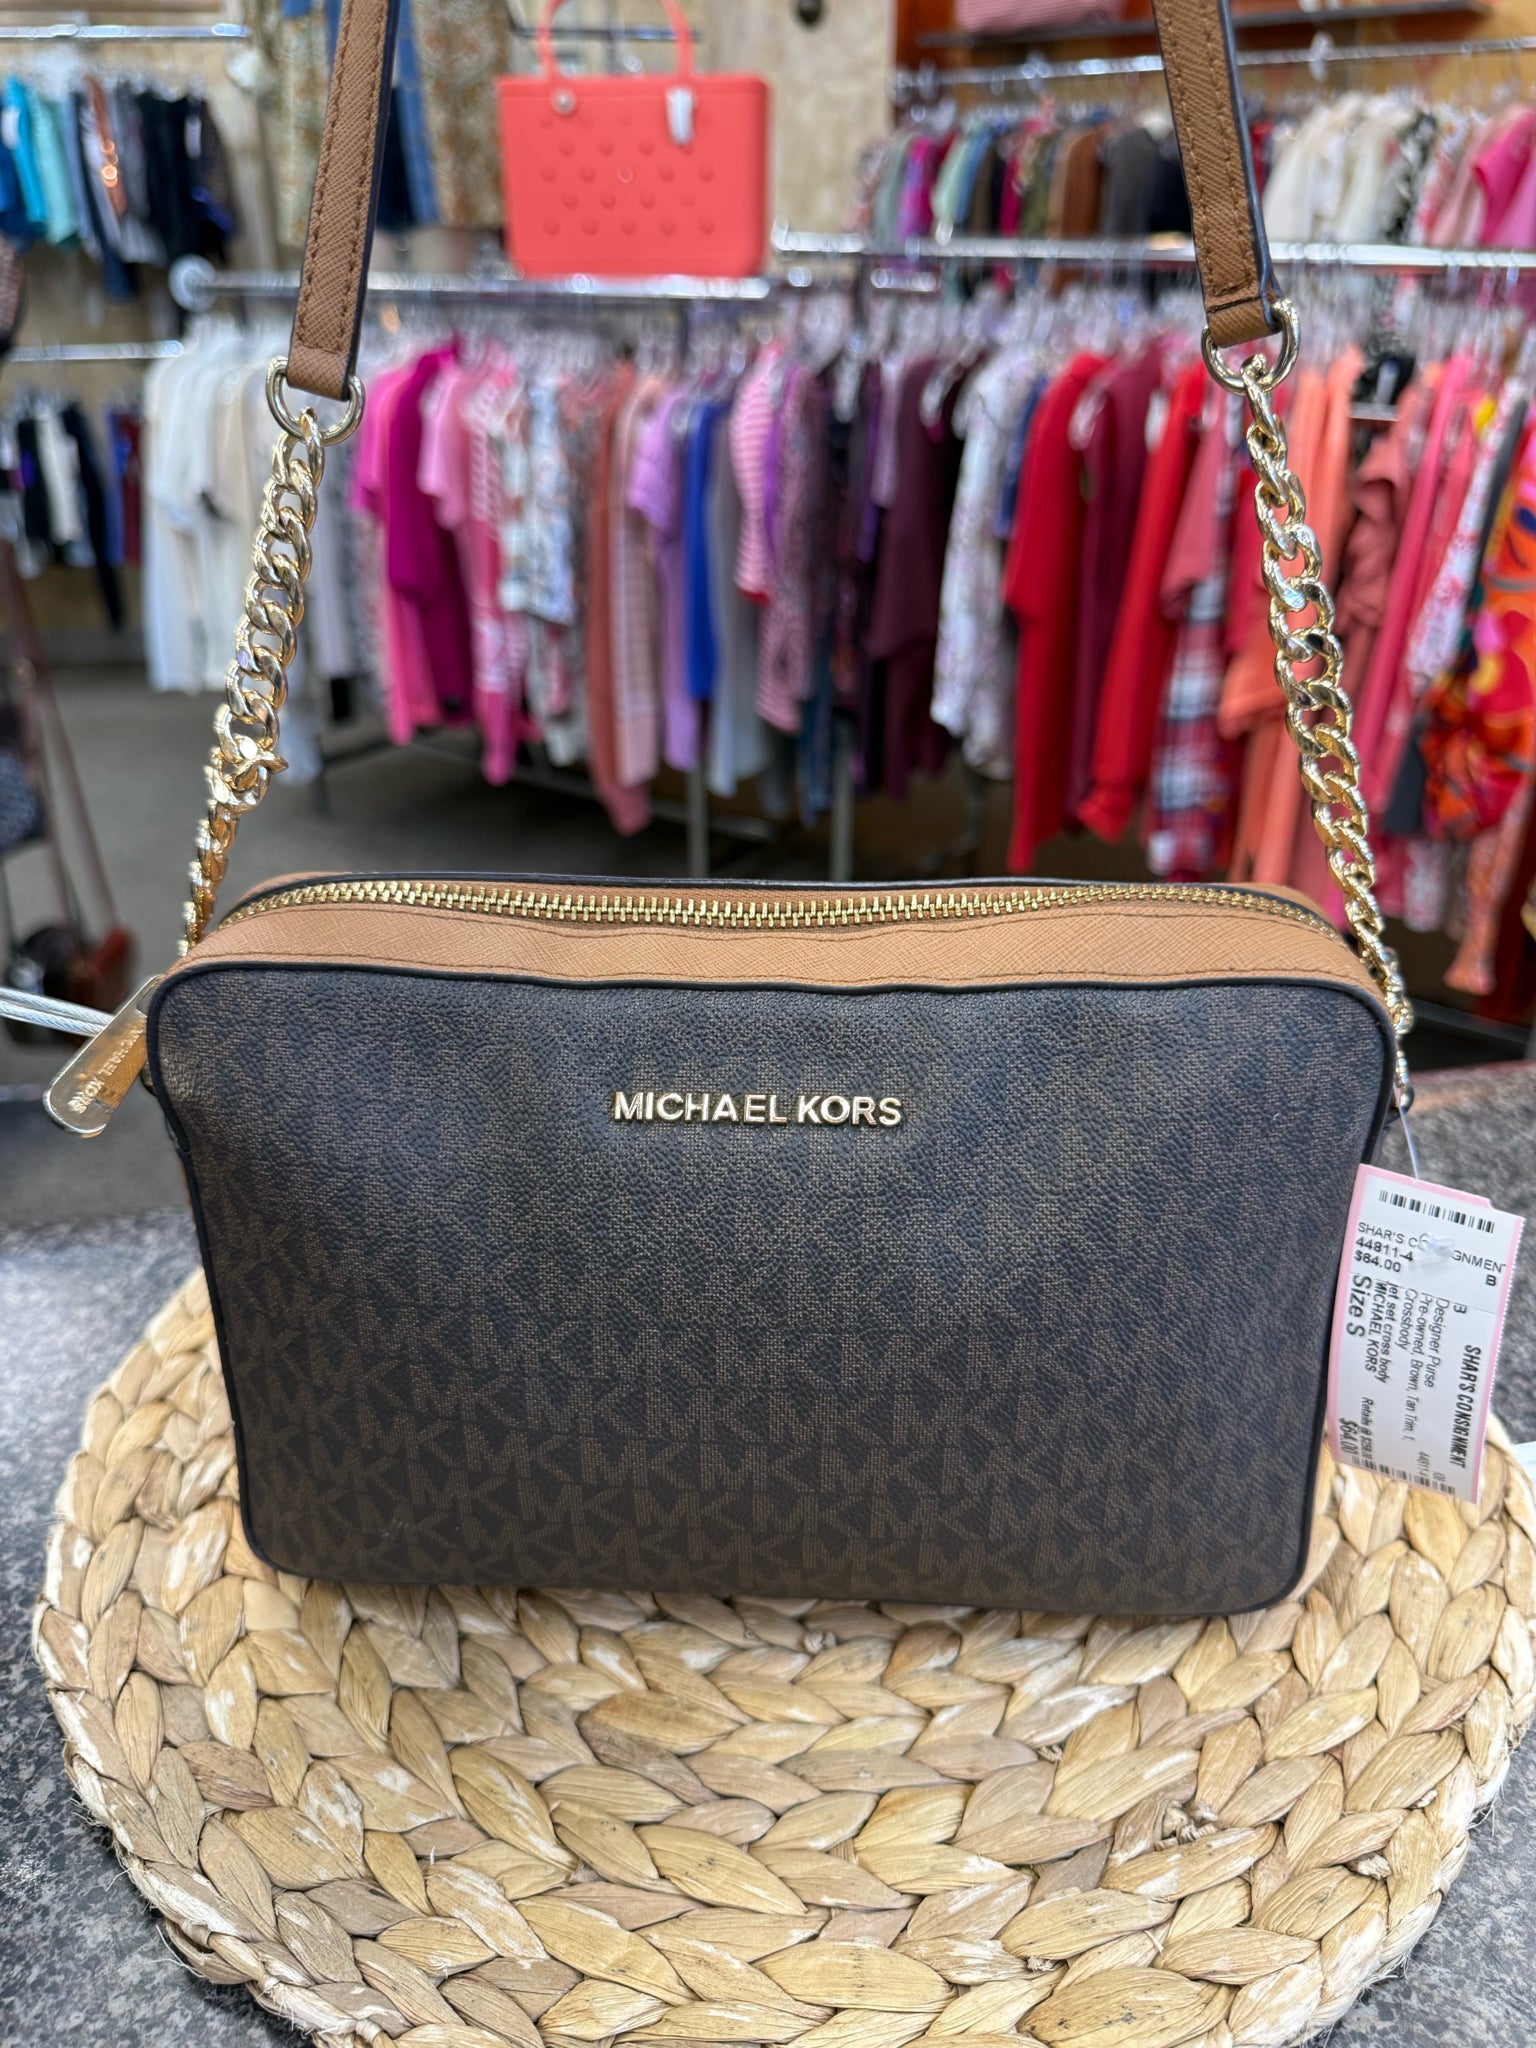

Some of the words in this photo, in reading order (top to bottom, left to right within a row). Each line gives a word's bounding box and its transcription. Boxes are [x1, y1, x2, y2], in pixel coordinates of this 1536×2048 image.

[67, 1078, 104, 1113] KORS
[613, 1091, 788, 1124] MICHAEL
[797, 1095, 902, 1127] KORS
[1354, 1250, 1401, 1272] $64.00
[1356, 1237, 1413, 1261] 44811-4
[1358, 1222, 1404, 1243] SHAR'S
[1408, 1237, 1506, 1272] CGNMEN
[1348, 1274, 1372, 1318] Size
[1485, 1274, 1497, 1286] B
[1368, 1279, 1387, 1336] MICHAEL
[1384, 1301, 1397, 1320] set
[1396, 1288, 1417, 1349] Crossbody
[1411, 1292, 1432, 1355] Pre-owned,
[1346, 1321, 1365, 1337] S
[1380, 1324, 1393, 1355] cross
[1429, 1297, 1449, 1353] Designer
[1364, 1338, 1379, 1372] KORS
[1374, 1357, 1391, 1383] body
[1424, 1354, 1439, 1387] Purse
[1458, 1344, 1481, 1393] SHAR'S
[1406, 1358, 1423, 1392] Brown,
[1360, 1396, 1373, 1426] Retails
[1405, 1396, 1418, 1411] Tan
[1339, 1417, 1358, 1454] $64.00
[1449, 1394, 1474, 1468] CONSIGNMENT
